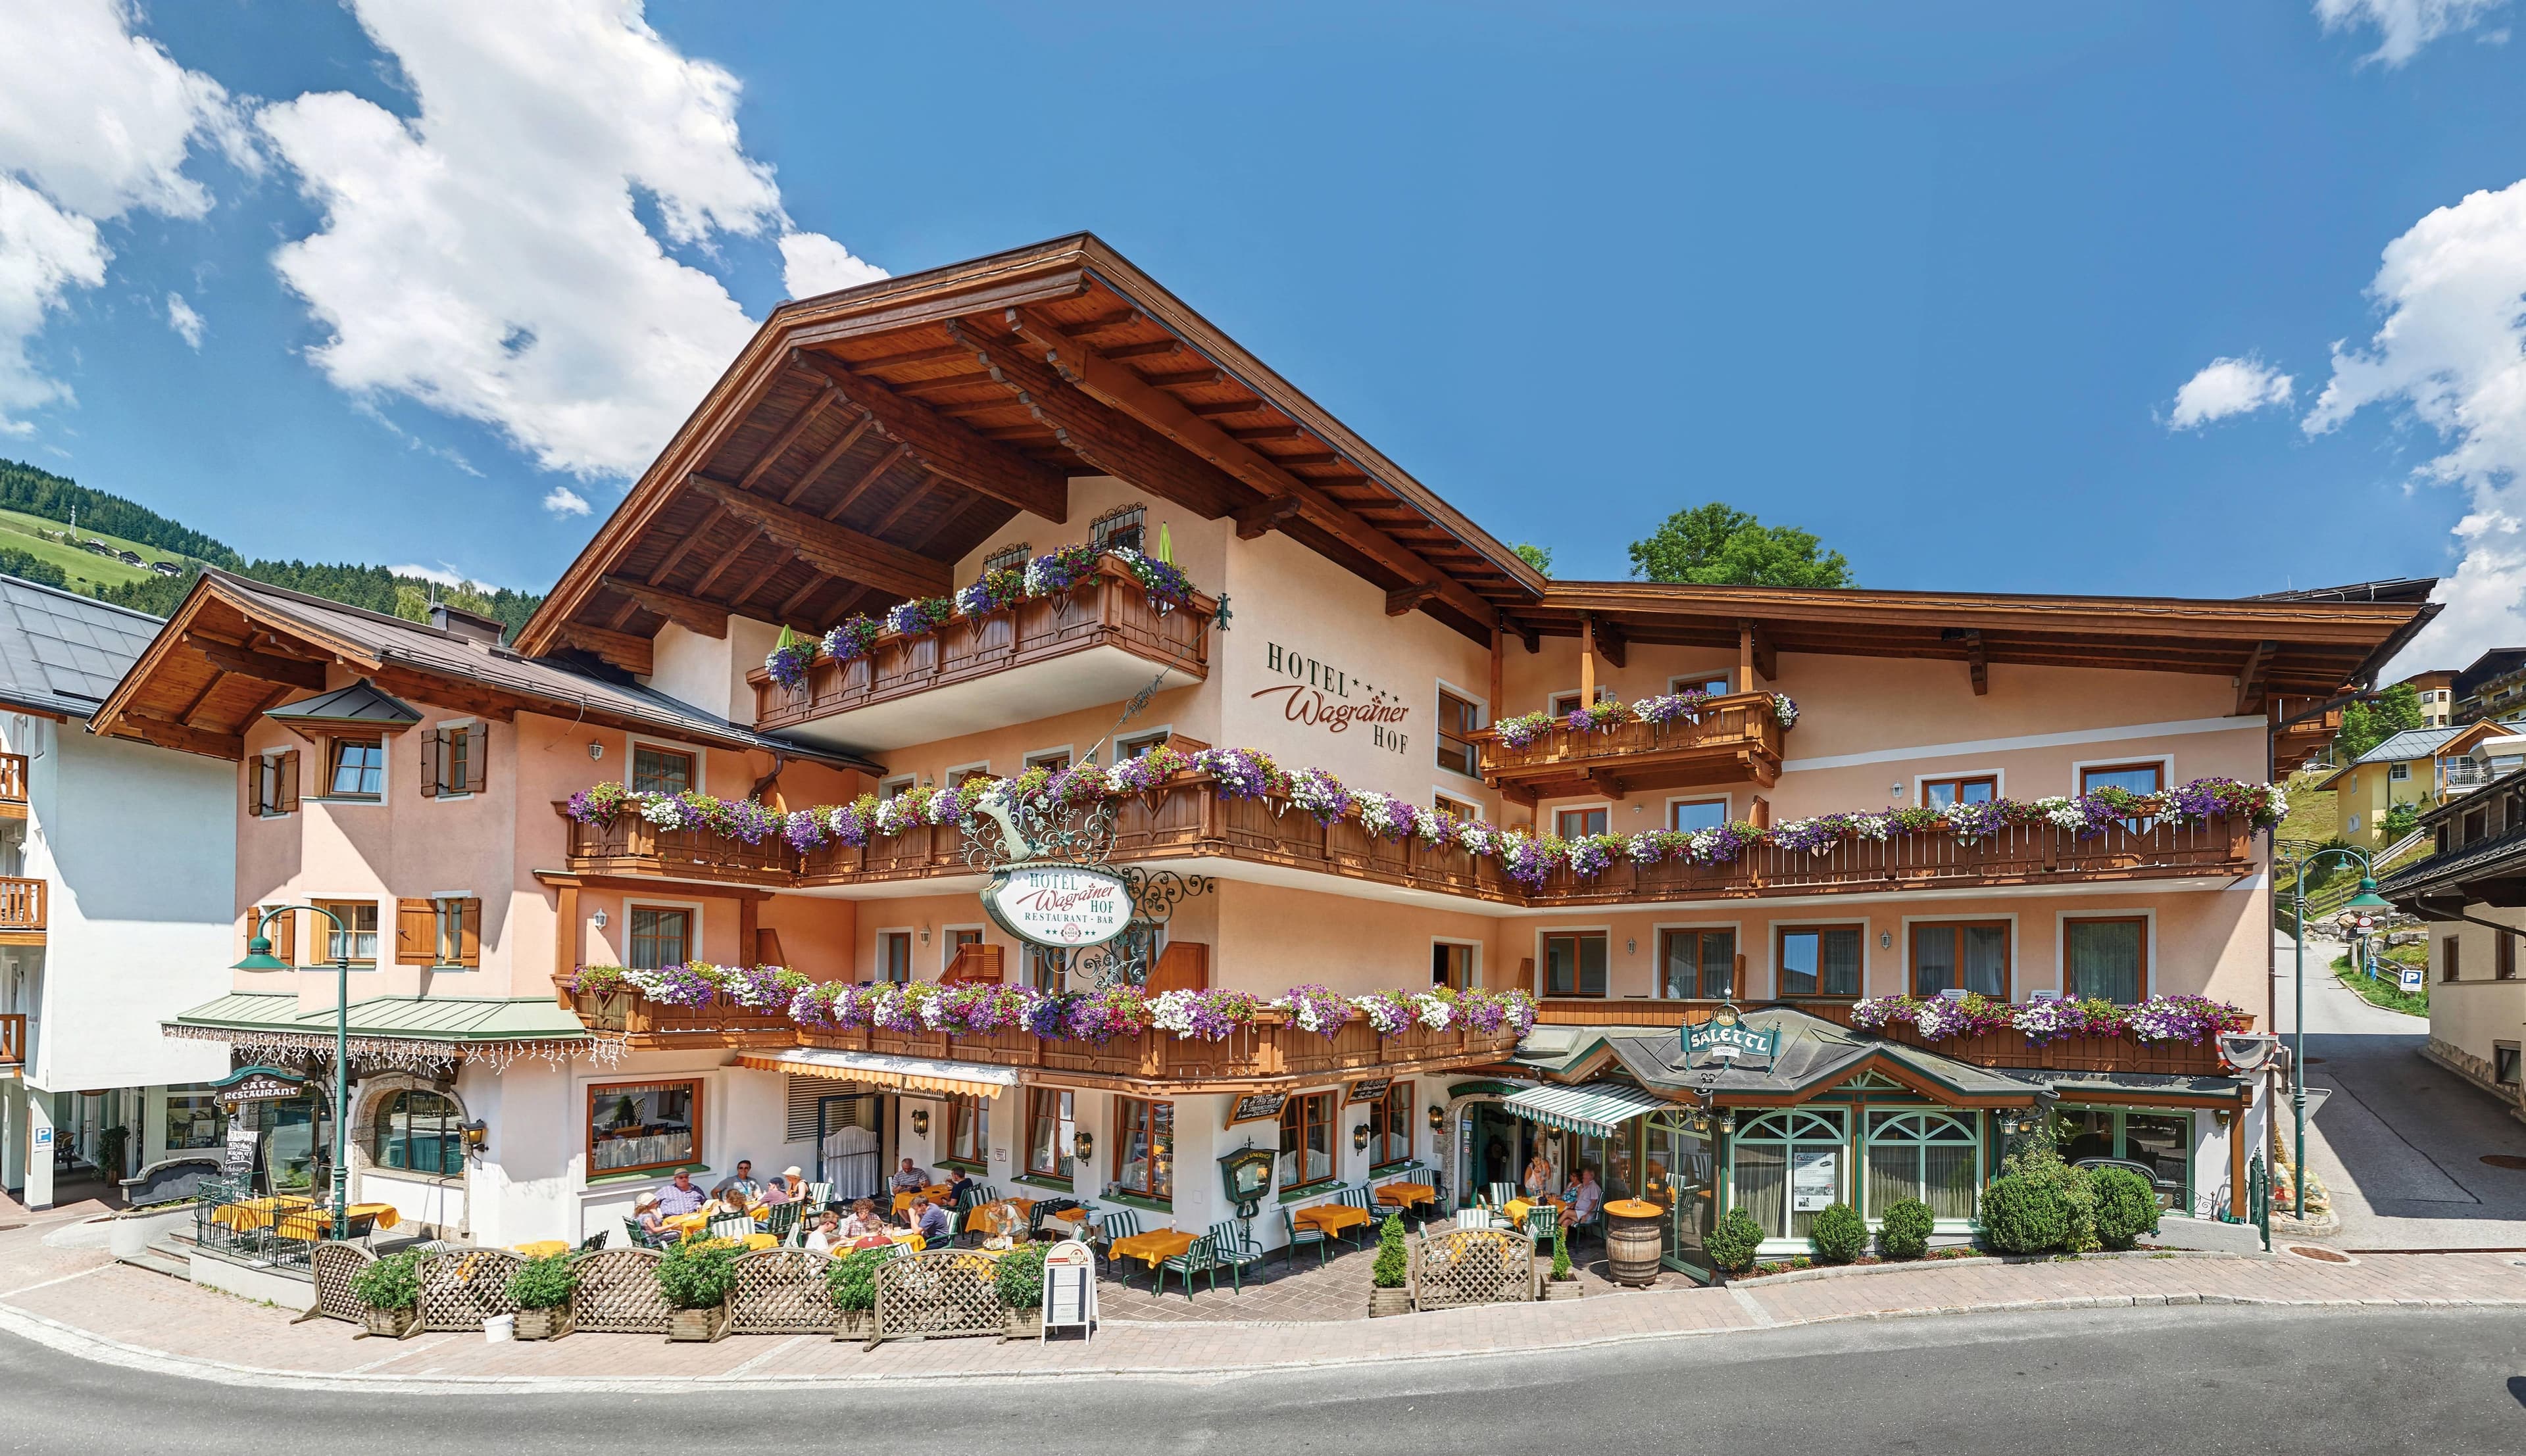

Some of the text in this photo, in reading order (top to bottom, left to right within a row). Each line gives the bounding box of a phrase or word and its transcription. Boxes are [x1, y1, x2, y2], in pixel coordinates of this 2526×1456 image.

[1267, 642, 1349, 697] HOTEL
[1251, 685, 1409, 733] Wagrainer
[1374, 724, 1408, 754] HOF
[1029, 873, 1079, 890] HOTEL
[1016, 885, 1115, 911] Wagrainer
[1091, 900, 1114, 913] HOF
[1025, 912, 1087, 923] RESTAURANT
[1097, 915, 1114, 924] BAR
[2406, 973, 2419, 983] P
[1718, 1011, 1735, 1023] BAR
[1691, 1029, 1768, 1052] SALETTL
[224, 1087, 297, 1100] RESTAURANT
[37, 1129, 50, 1140] P
